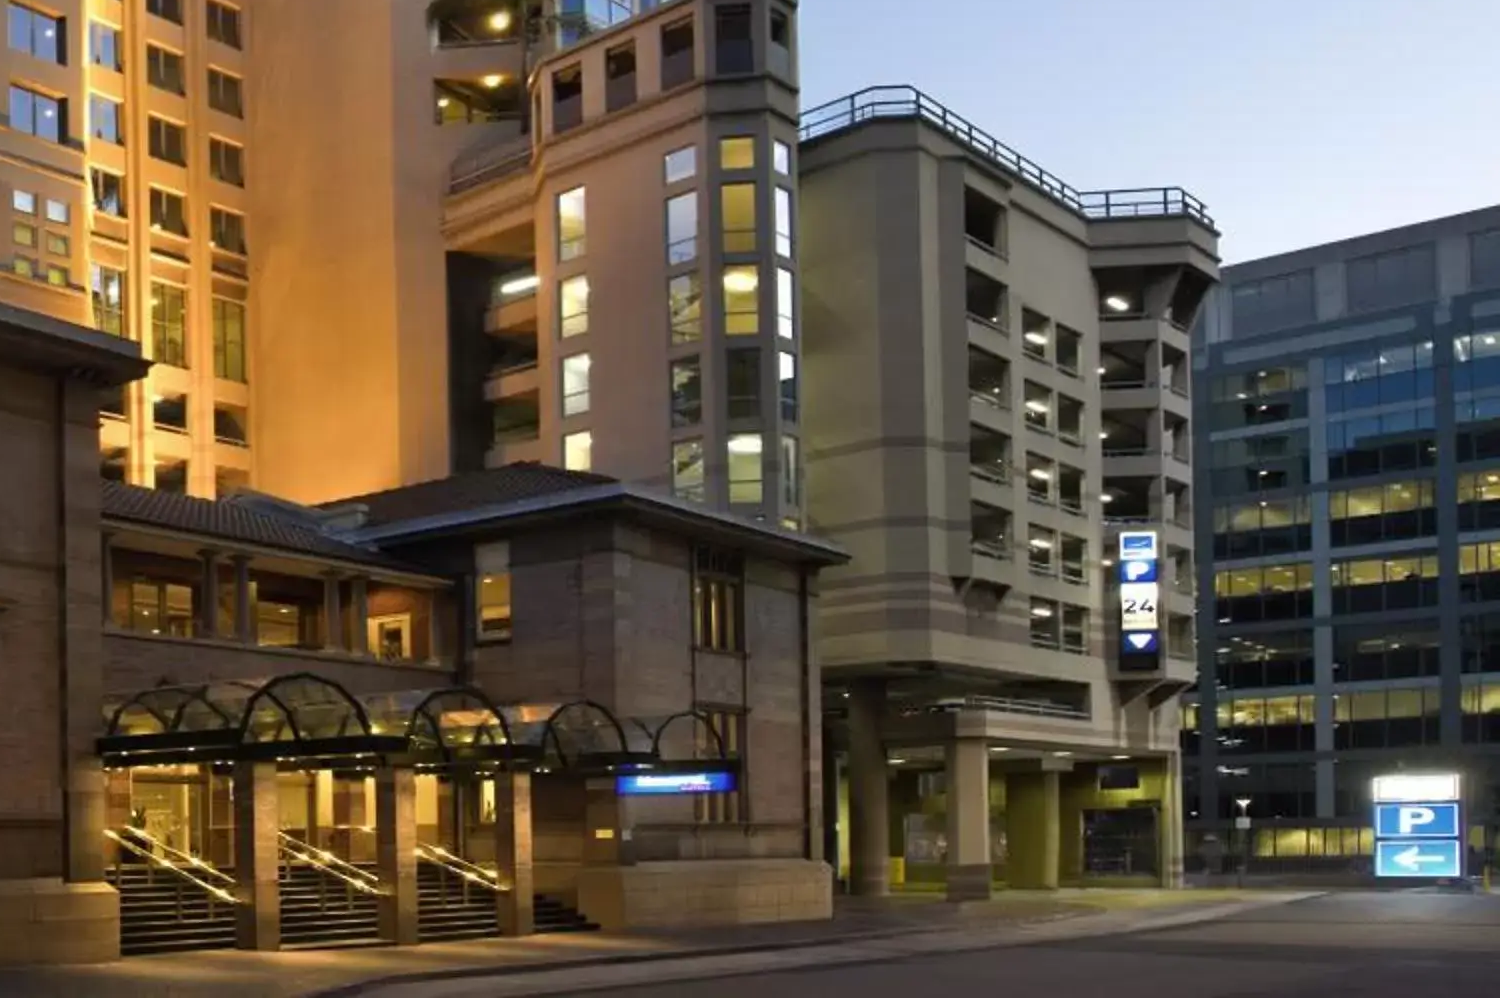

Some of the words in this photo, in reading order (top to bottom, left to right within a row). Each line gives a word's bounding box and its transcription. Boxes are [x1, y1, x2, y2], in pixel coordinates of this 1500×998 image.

[1126, 561, 1150, 581] P
[1123, 598, 1155, 614] 24
[1399, 806, 1436, 834] P
